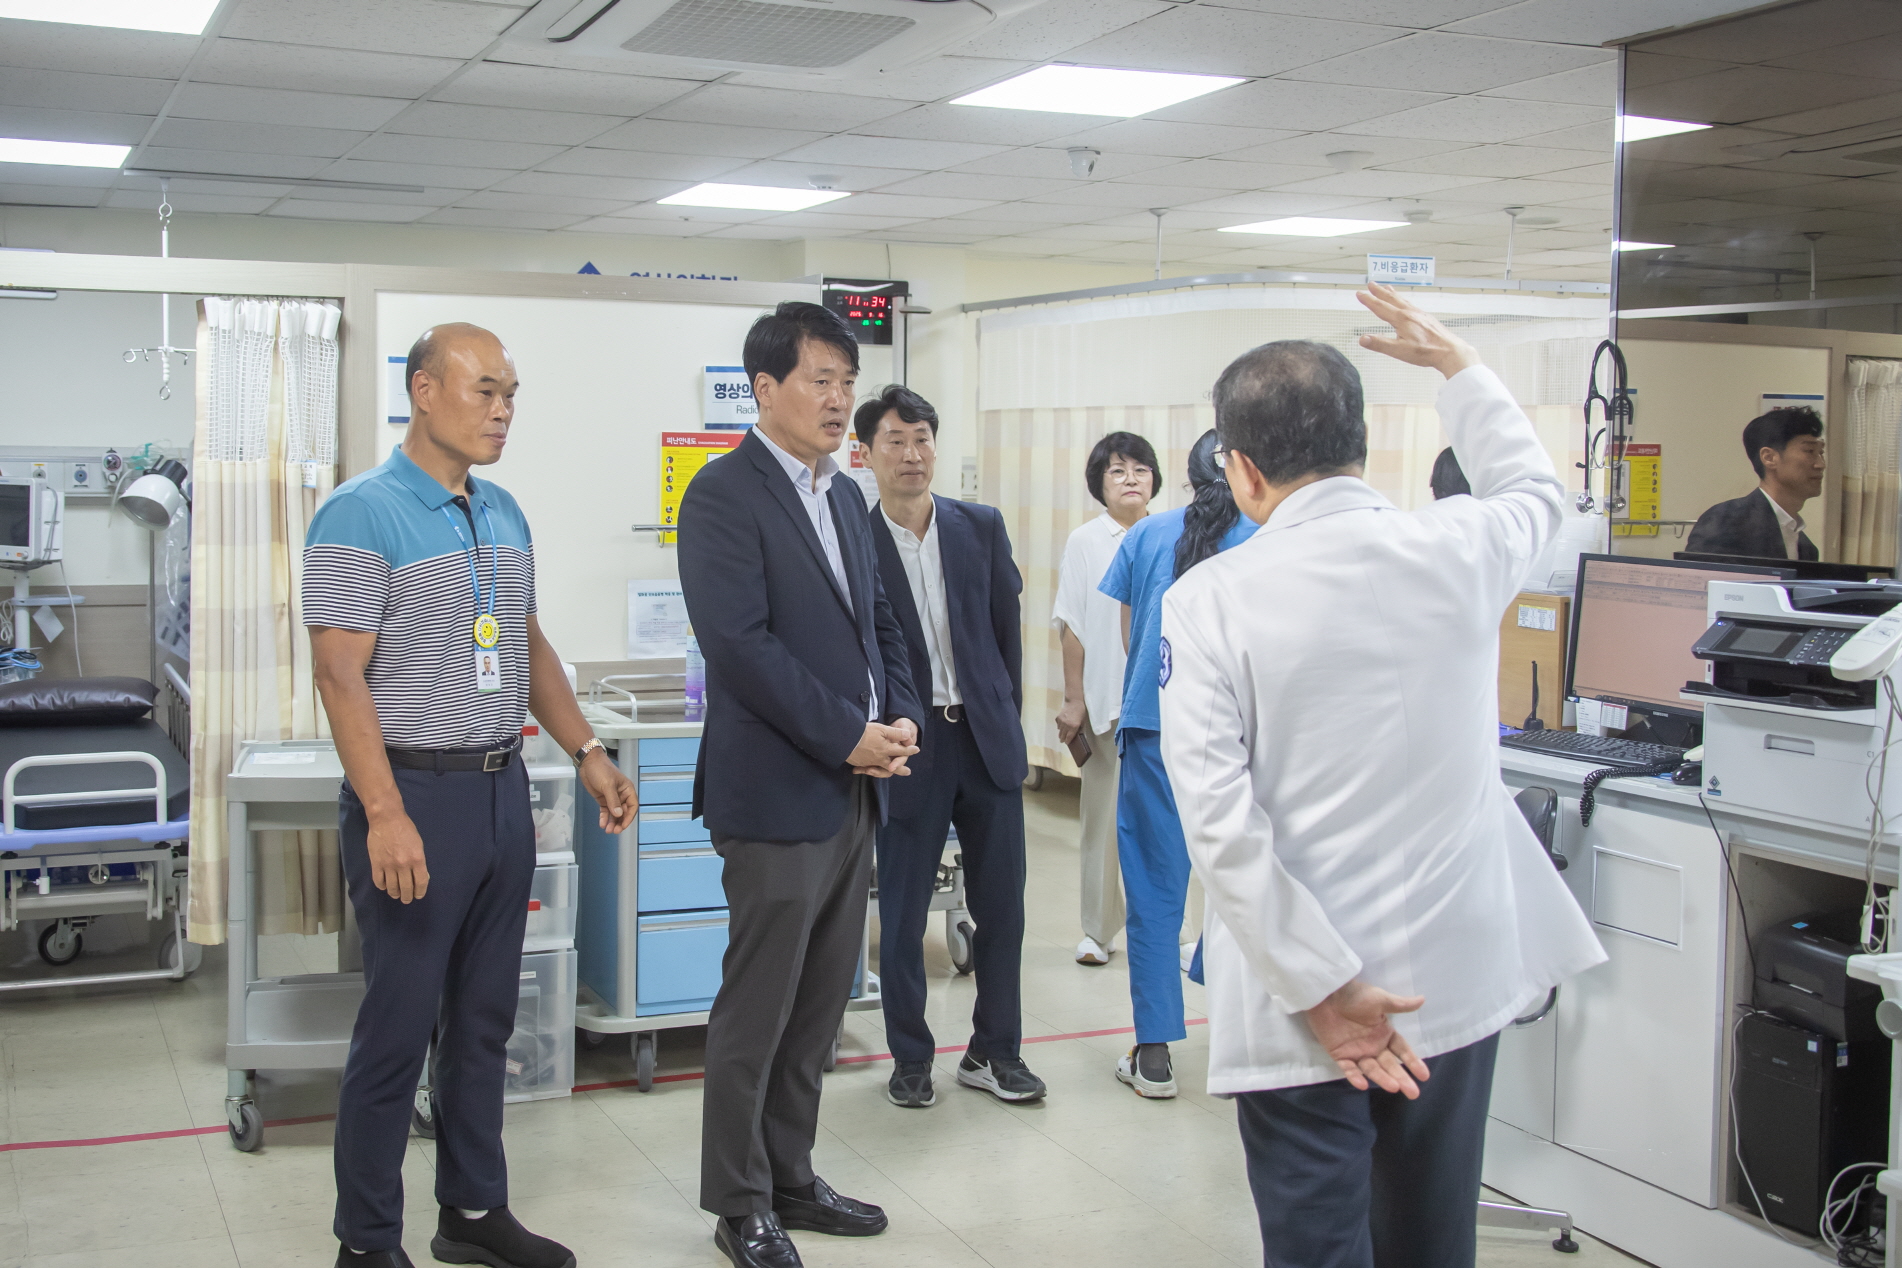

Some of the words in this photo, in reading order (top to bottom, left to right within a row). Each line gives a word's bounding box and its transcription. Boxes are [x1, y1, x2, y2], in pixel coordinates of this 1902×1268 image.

[1372, 261, 1429, 274] 7.비응급환자
[871, 296, 886, 308] 34
[666, 437, 697, 445] 피난안내도
[1724, 593, 1744, 602] EPSON
[1866, 750, 1875, 758] C1
